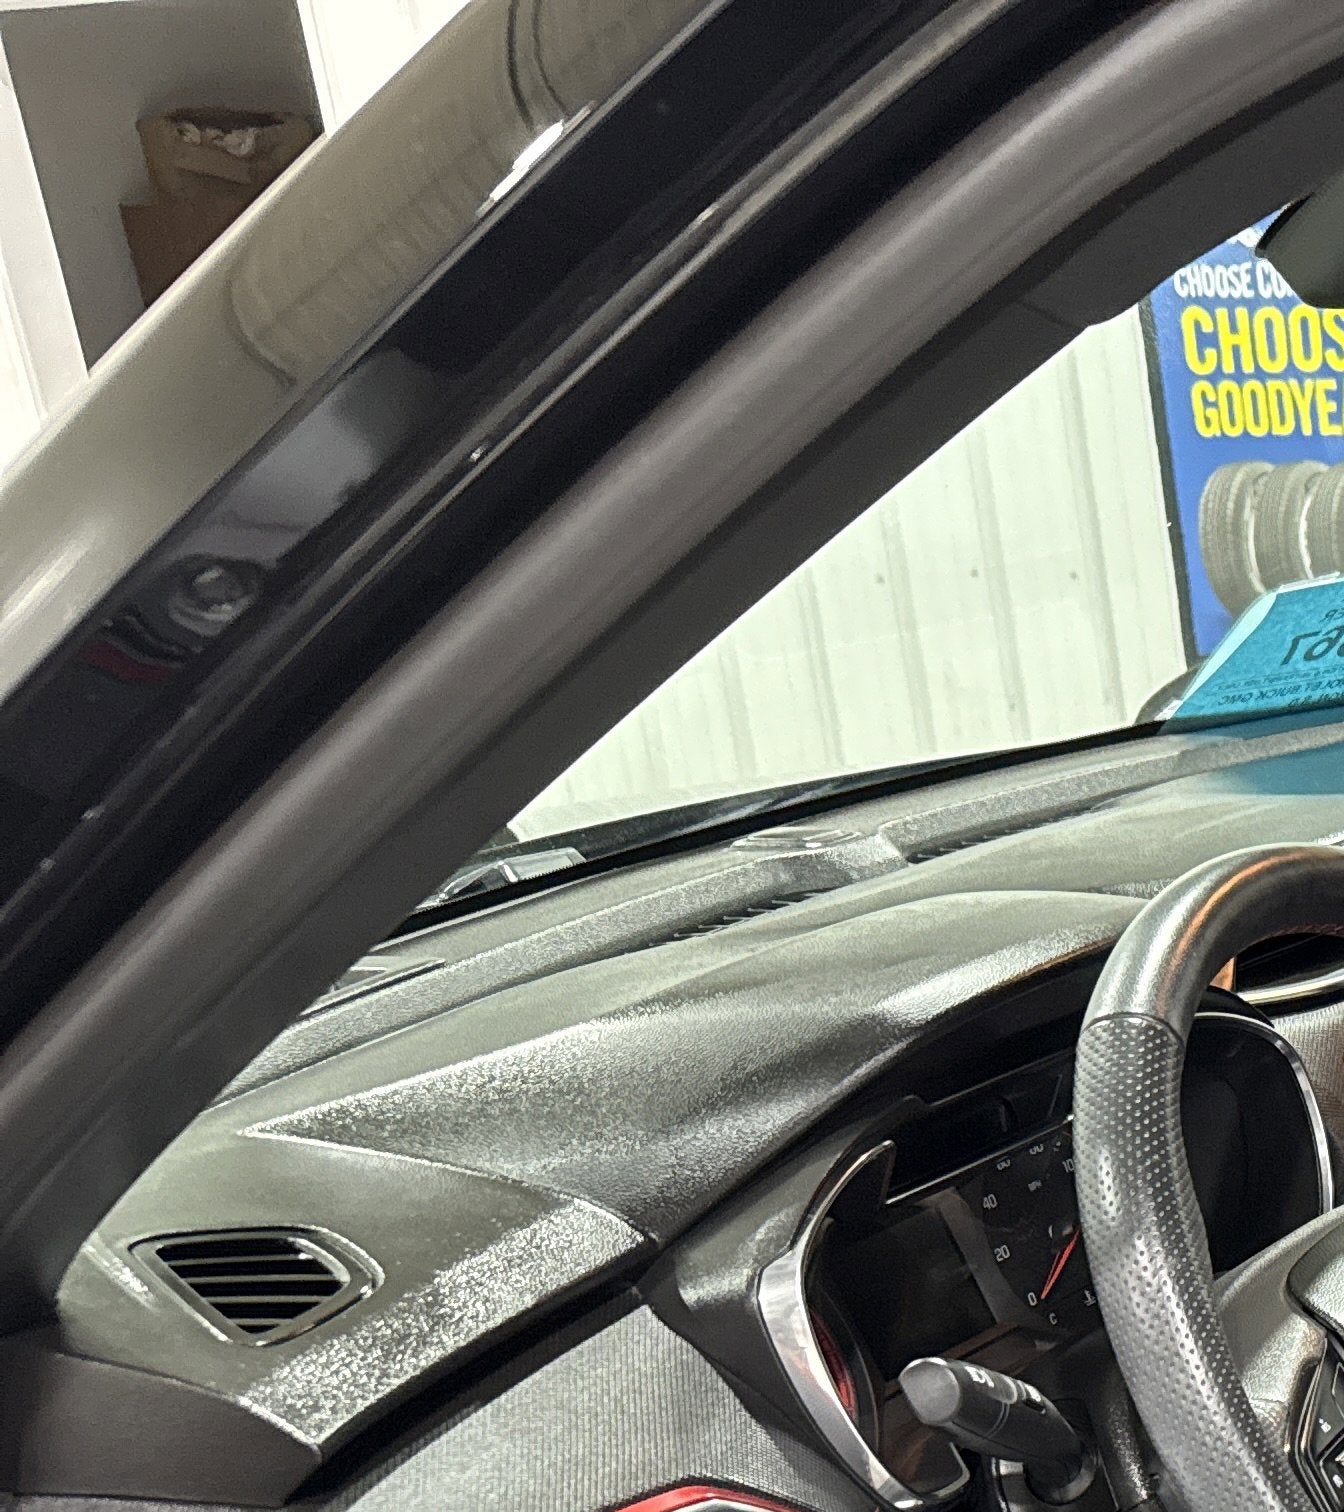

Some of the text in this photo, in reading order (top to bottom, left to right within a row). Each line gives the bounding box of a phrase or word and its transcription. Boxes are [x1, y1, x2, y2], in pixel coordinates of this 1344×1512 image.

[1173, 257, 1297, 299] CHOOSE CO
[994, 1245, 1011, 1262] 20
[1027, 1292, 1038, 1306] 0
